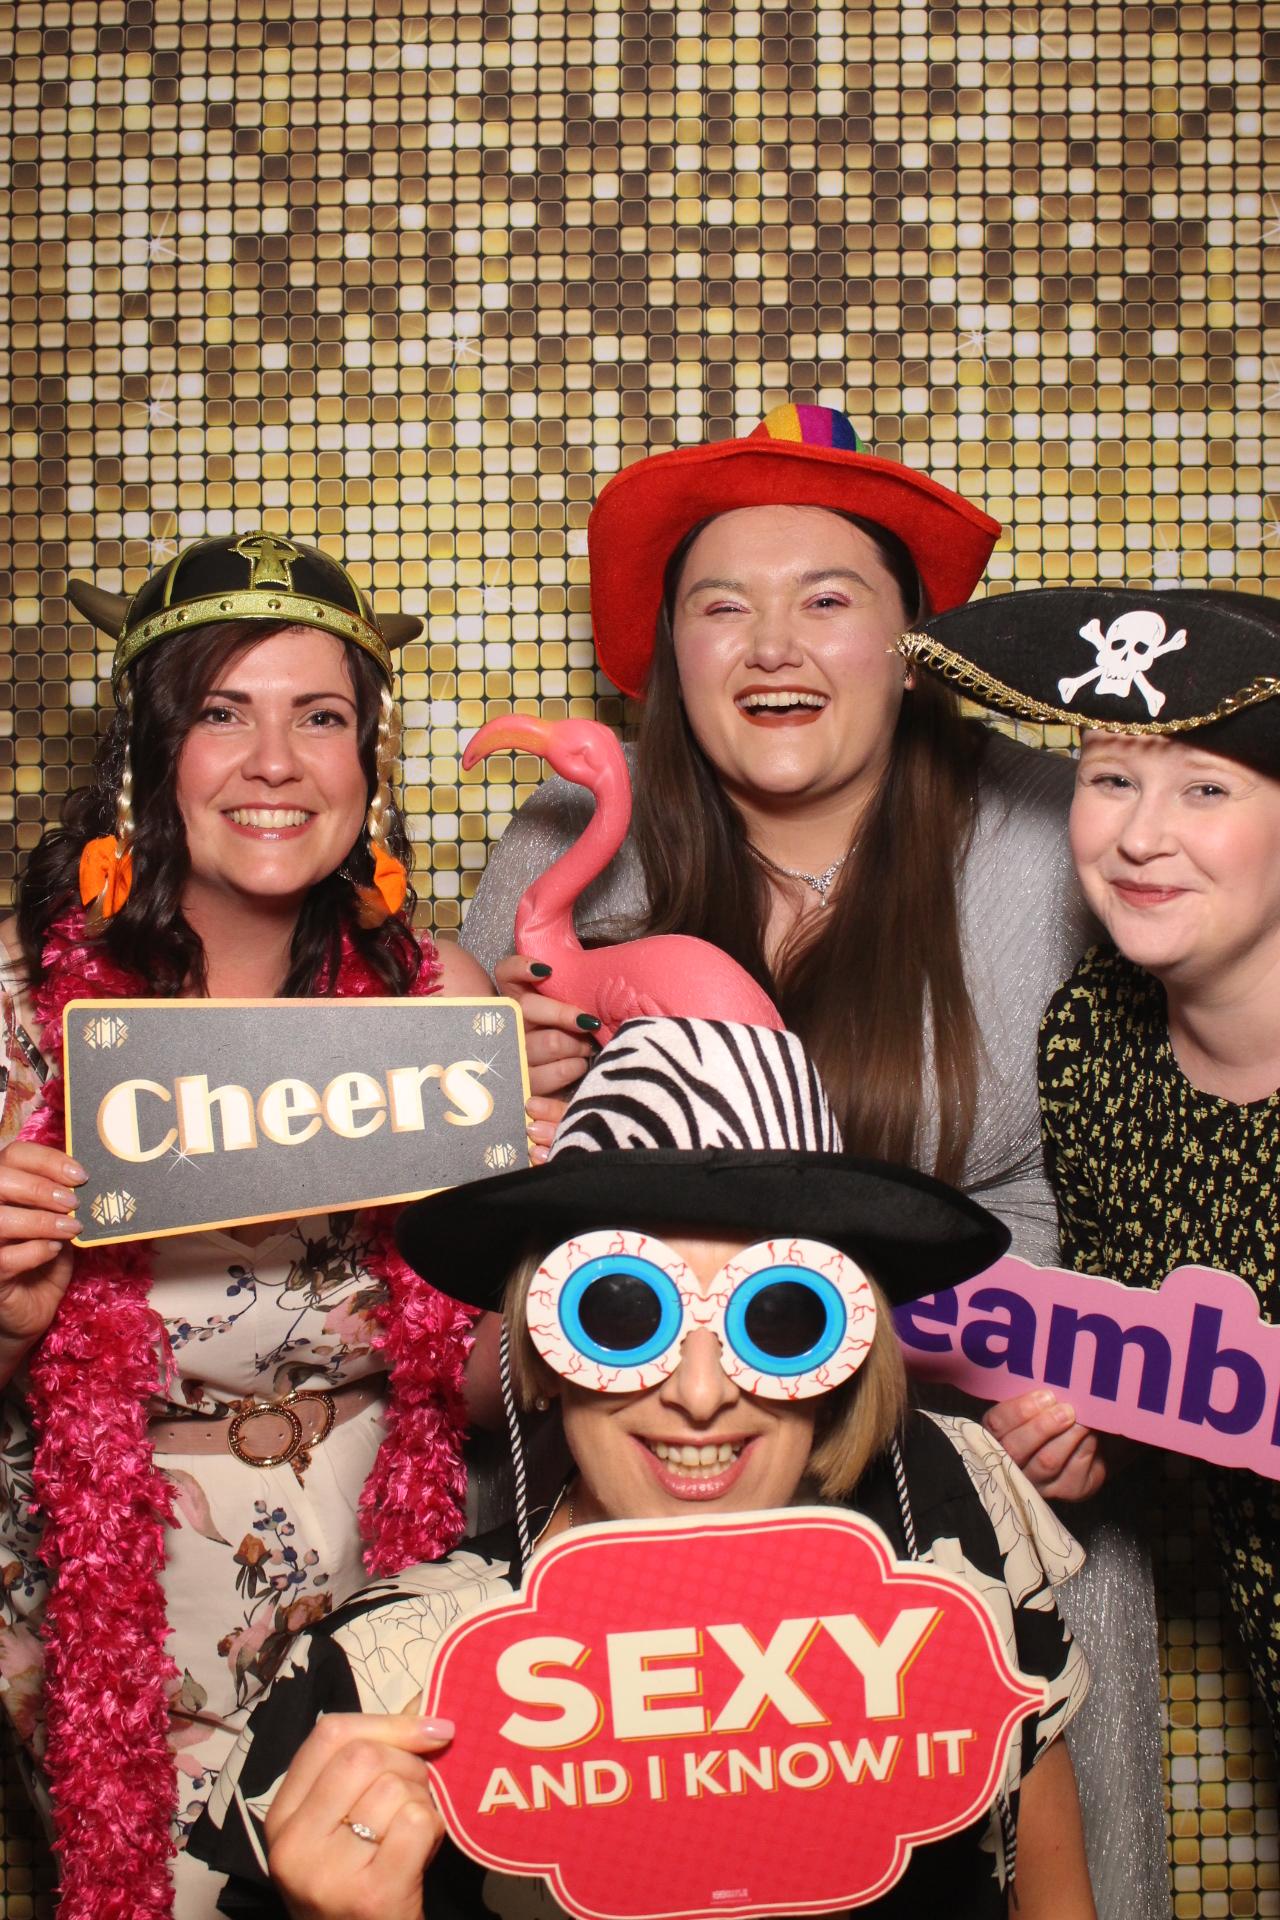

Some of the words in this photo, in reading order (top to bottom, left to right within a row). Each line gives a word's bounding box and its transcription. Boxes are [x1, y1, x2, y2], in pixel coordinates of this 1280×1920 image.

[97, 1060, 494, 1162] Cheers
[892, 1287, 1280, 1446] eamb
[496, 1606, 945, 1750] SEXY
[477, 1759, 632, 1815] AND
[649, 1755, 667, 1801] I
[684, 1735, 903, 1797] KNOW
[917, 1729, 976, 1779] IT
